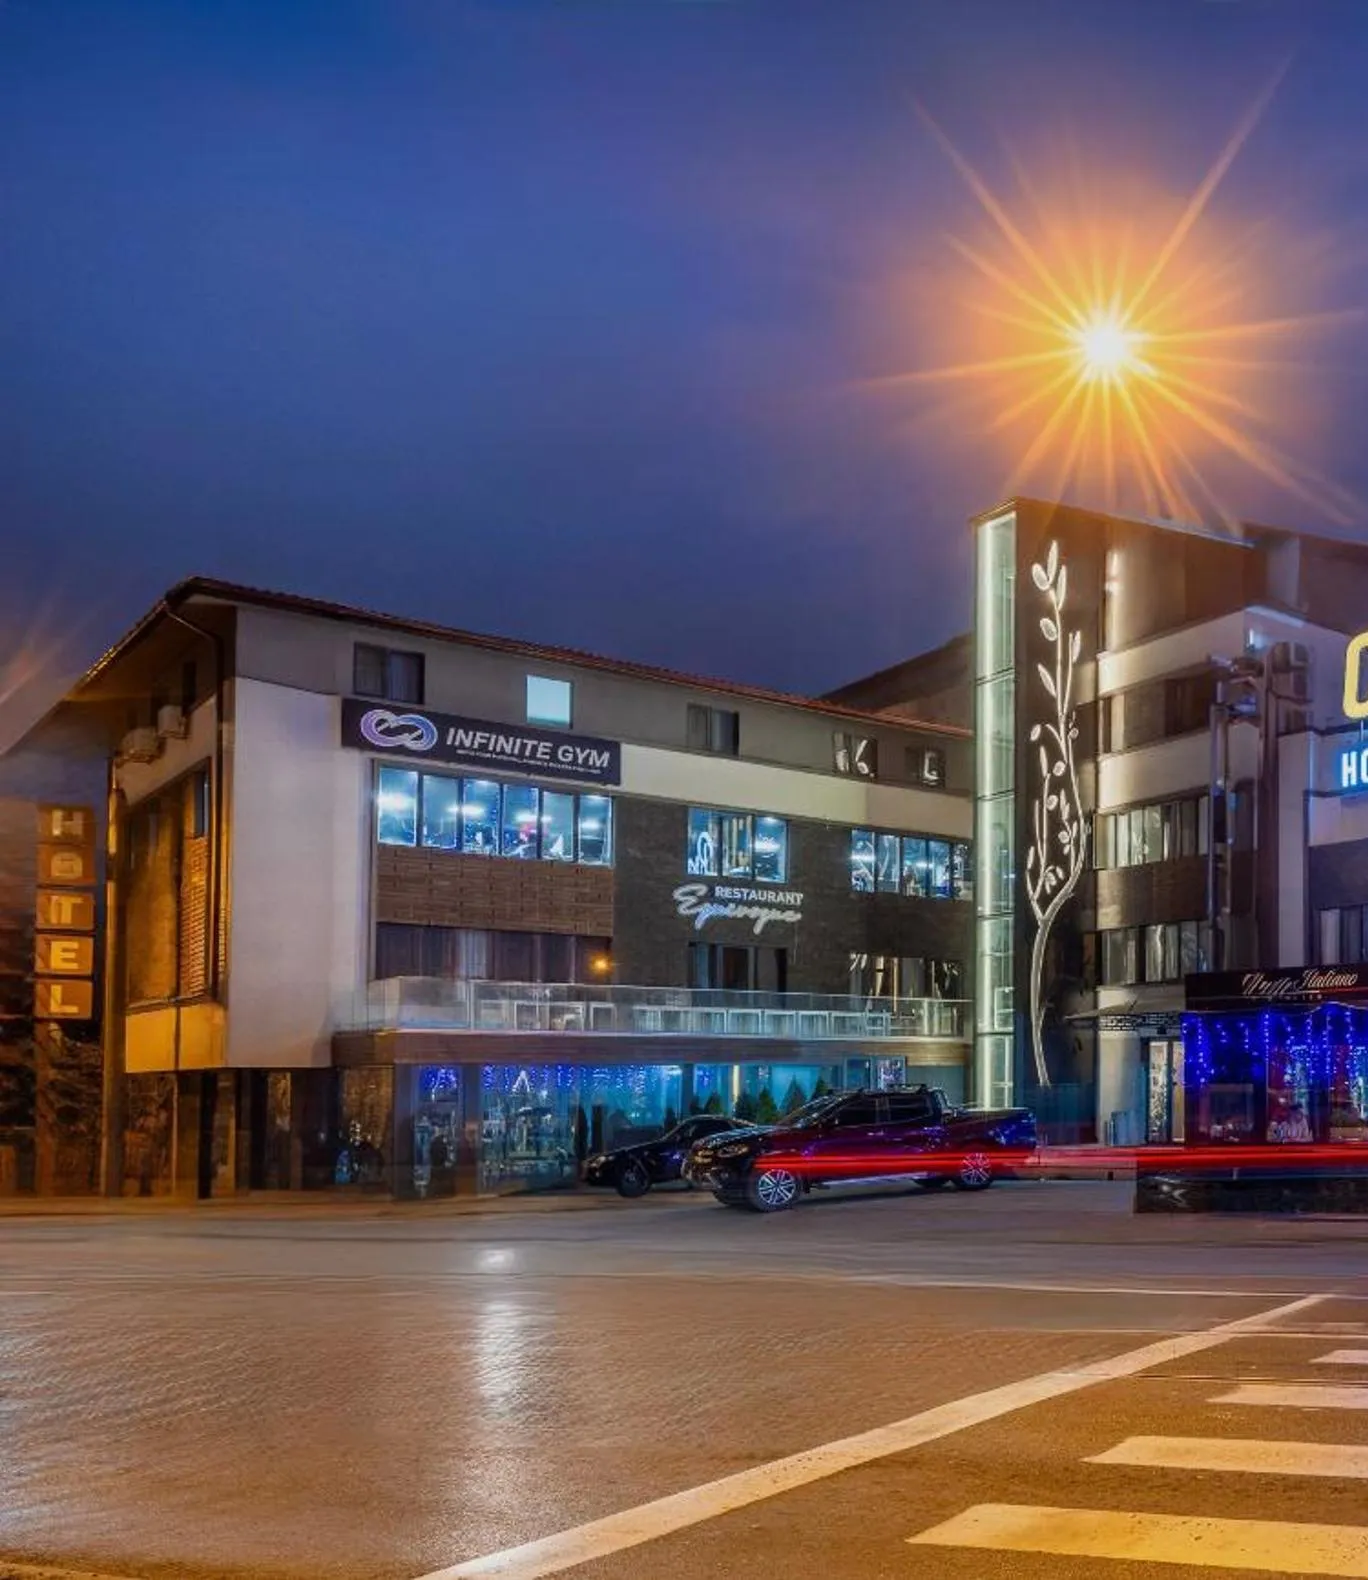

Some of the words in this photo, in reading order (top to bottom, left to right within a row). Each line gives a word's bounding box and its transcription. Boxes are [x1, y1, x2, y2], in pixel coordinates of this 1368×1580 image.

[446, 726, 554, 760] INFINITE
[557, 744, 610, 769] GYM
[50, 809, 84, 1014] HOTEL
[714, 886, 804, 905] RESTAURANT
